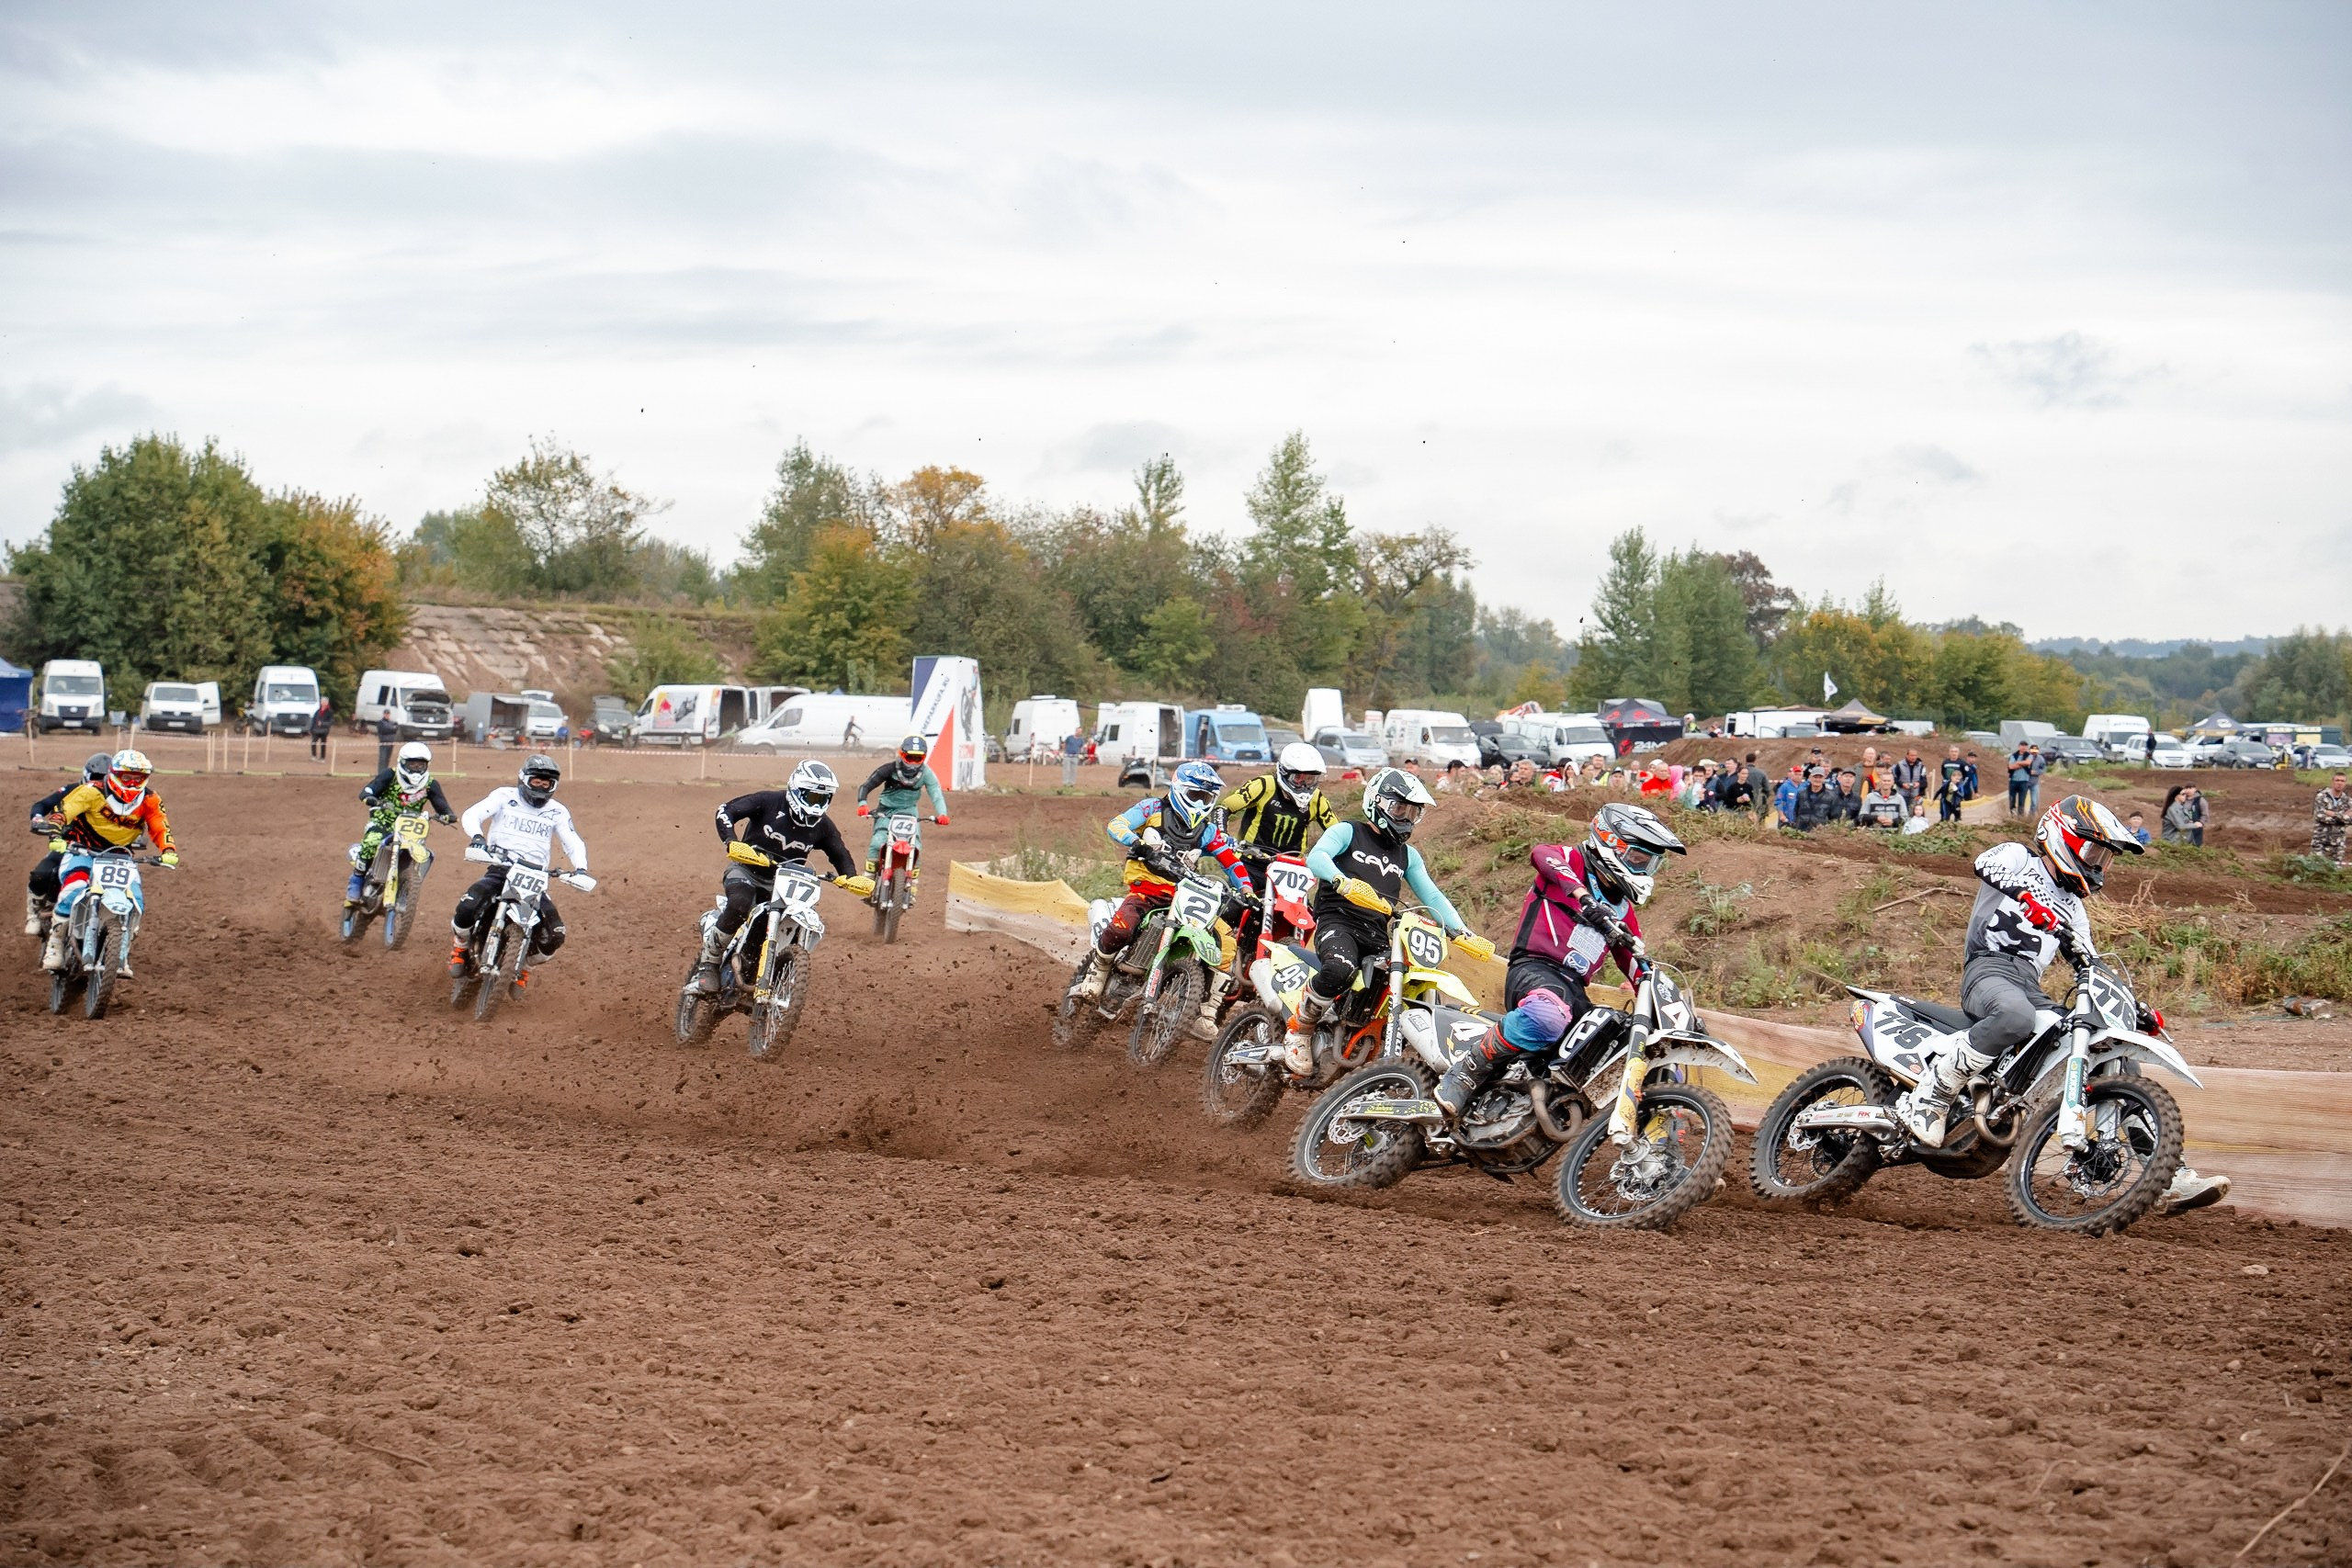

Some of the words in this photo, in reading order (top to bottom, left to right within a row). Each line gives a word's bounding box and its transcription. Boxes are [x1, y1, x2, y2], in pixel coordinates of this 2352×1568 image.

[399, 819, 426, 836] 28
[894, 821, 913, 832] 44
[100, 865, 130, 886] 89
[511, 872, 545, 894] 836
[1272, 869, 1309, 893] 702
[785, 879, 816, 903] 17
[1183, 895, 1212, 924] 2
[1409, 929, 1442, 964] 95
[1274, 964, 1308, 993] 95
[2092, 977, 2135, 1031] 776
[1857, 1110, 1871, 1118] RK
